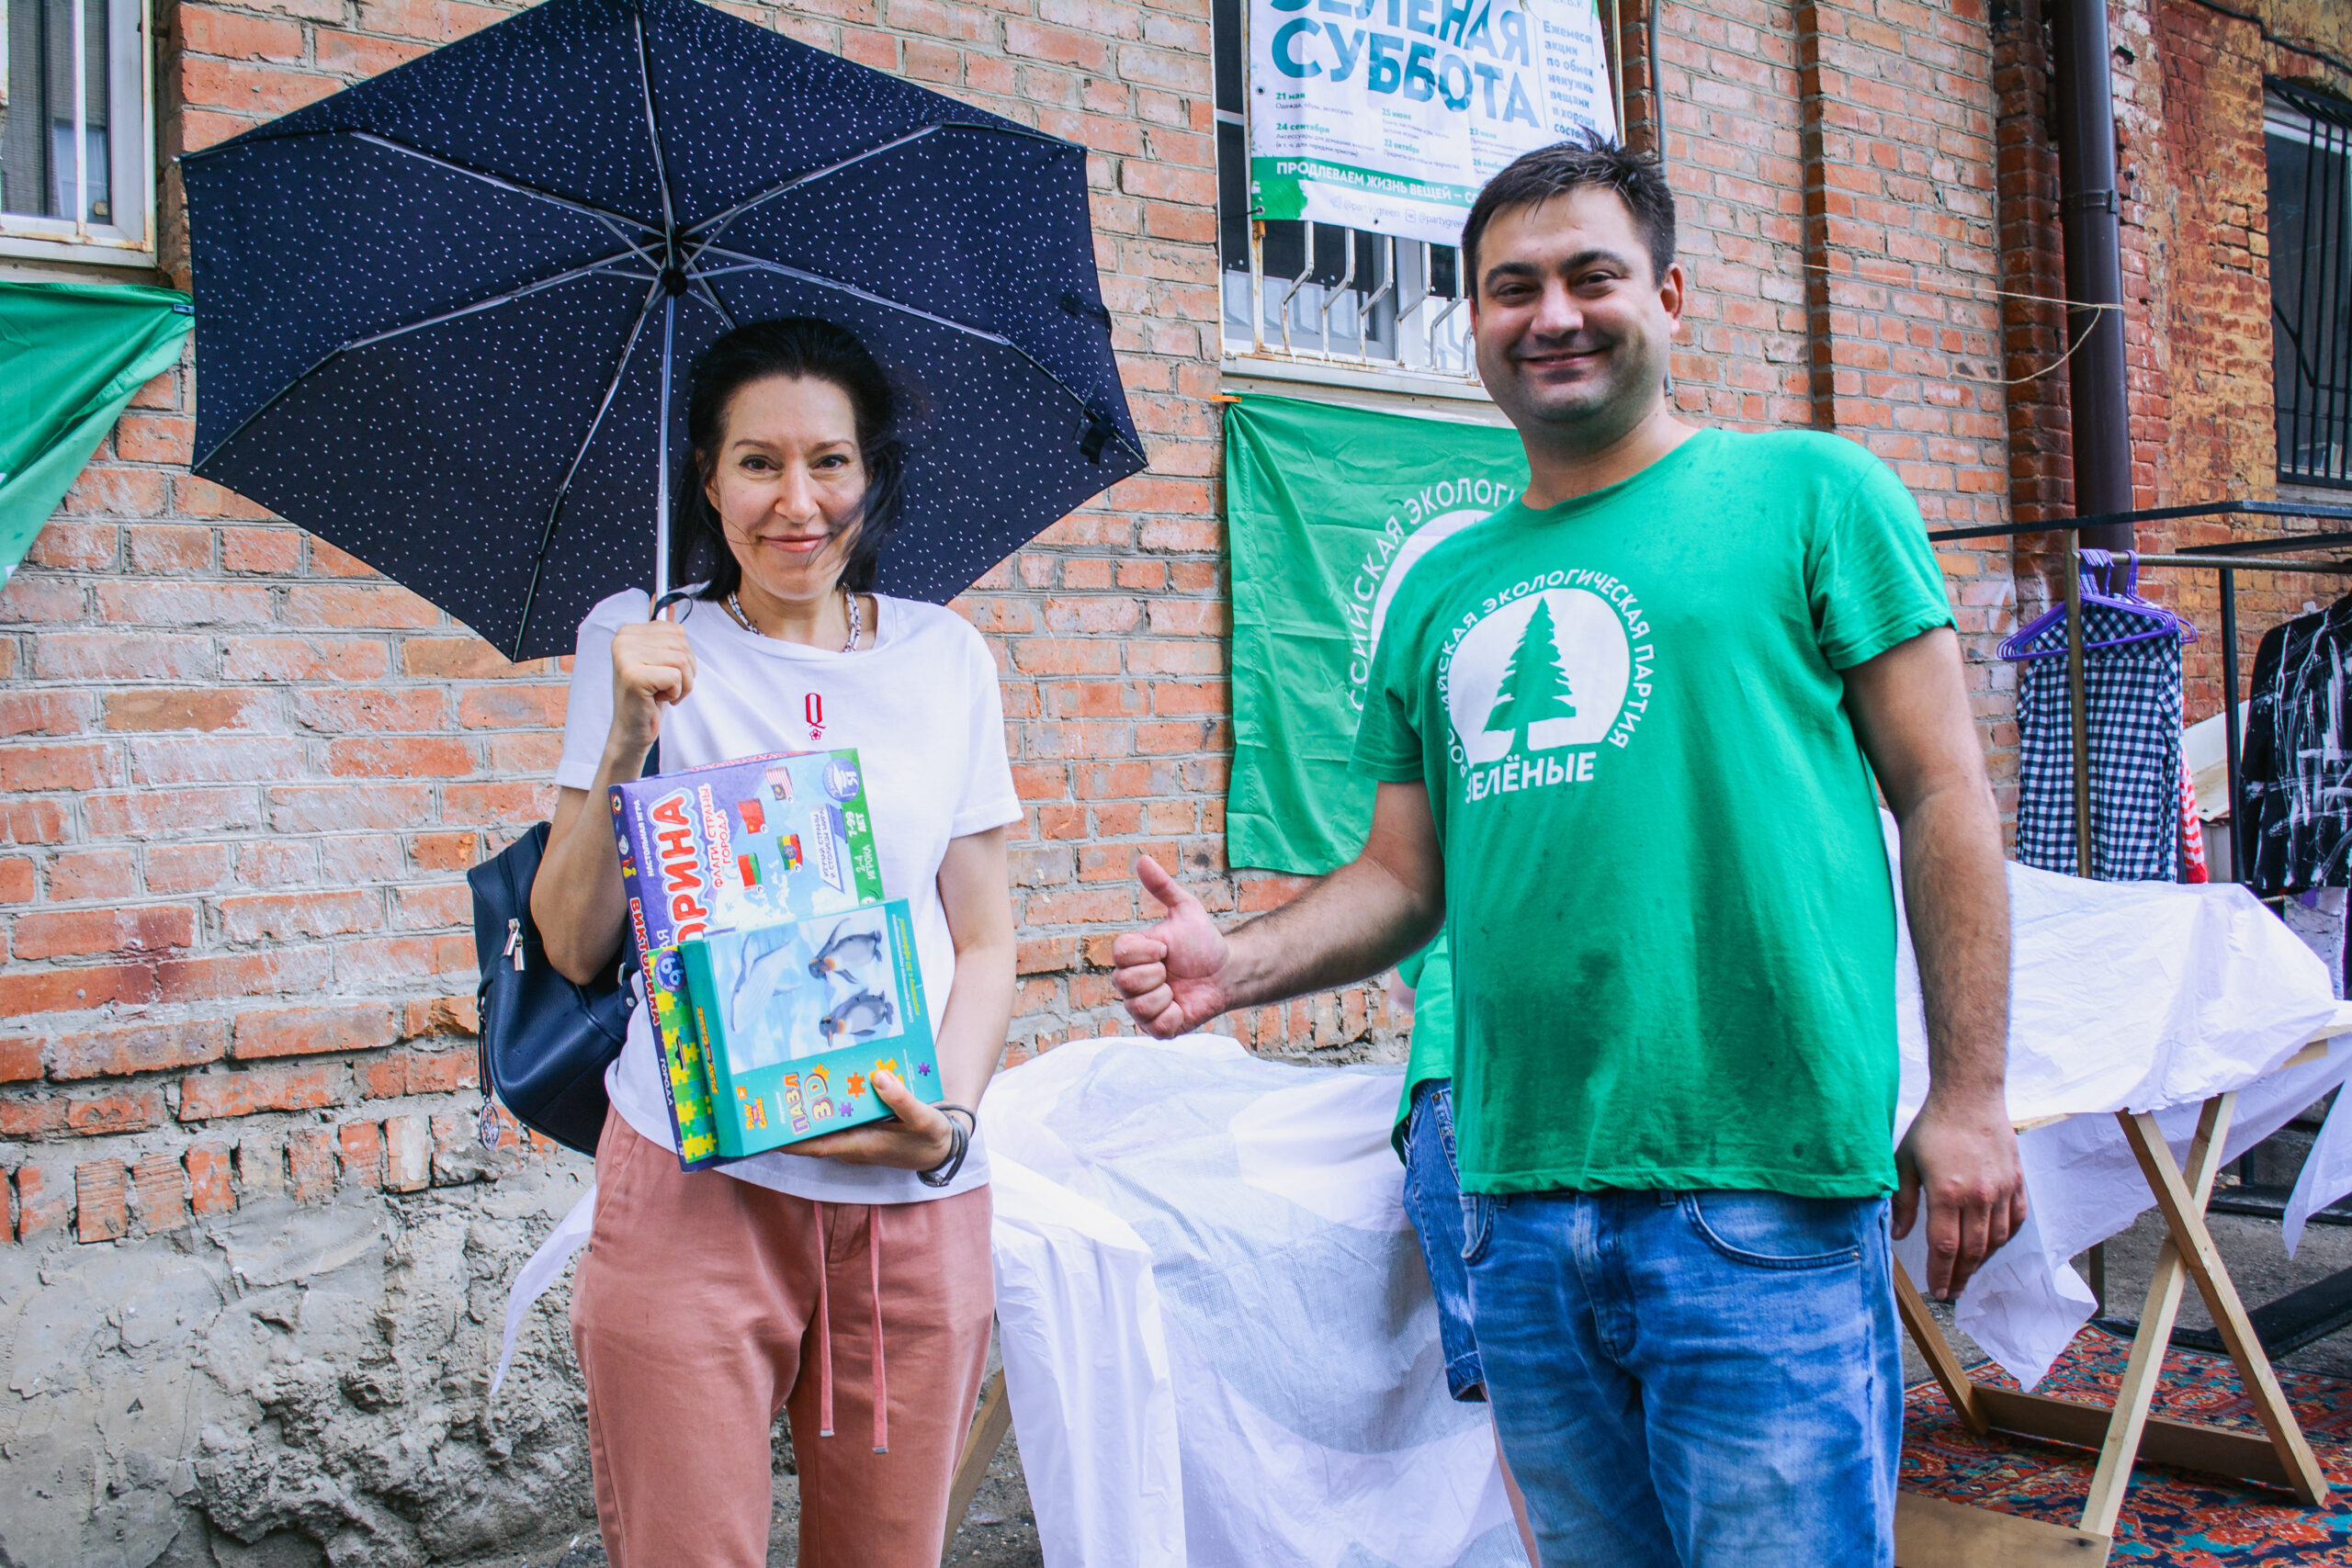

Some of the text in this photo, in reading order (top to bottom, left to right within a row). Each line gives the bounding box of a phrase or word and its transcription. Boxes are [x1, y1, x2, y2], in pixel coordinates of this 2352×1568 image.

[1272, 17, 1541, 129] СУББОТА
[1276, 162, 1364, 186] ПРОДЛЕВАЕМ
[1366, 175, 1398, 195] ЖИЗНЬ
[1409, 183, 1452, 201] ВЕЩЕЙ
[1482, 569, 1650, 639] ЭКОЛОГИЧЕСКАЯ
[1608, 644, 1655, 749] ПАРТИЯ
[805, 693, 827, 729] Q
[633, 799, 654, 877] НАСТОЛЬНАЯ ИГРА
[716, 811, 732, 864] ГОРОДА
[784, 1072, 810, 1135] ПАЗЛ
[804, 1073, 834, 1122] 3D
